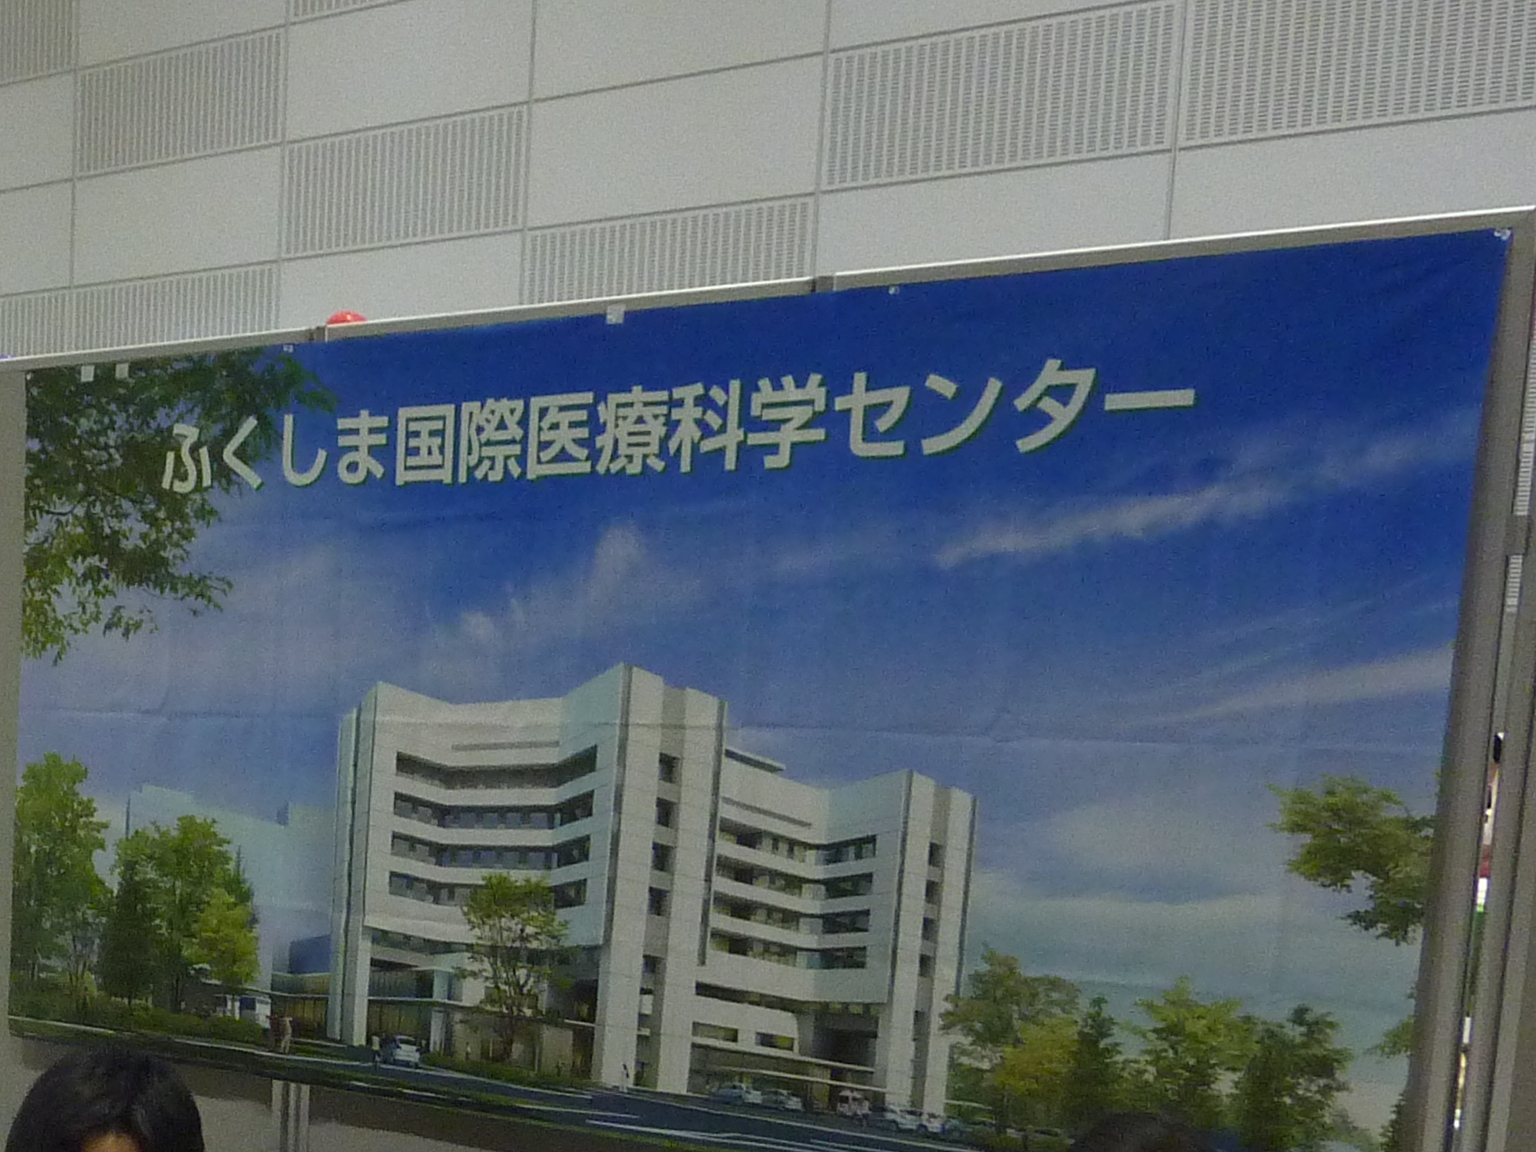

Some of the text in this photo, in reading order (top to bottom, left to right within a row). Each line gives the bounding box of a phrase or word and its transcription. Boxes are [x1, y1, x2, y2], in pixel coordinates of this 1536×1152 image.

[160, 357, 1197, 494] ふくしま国際医療科学センター
